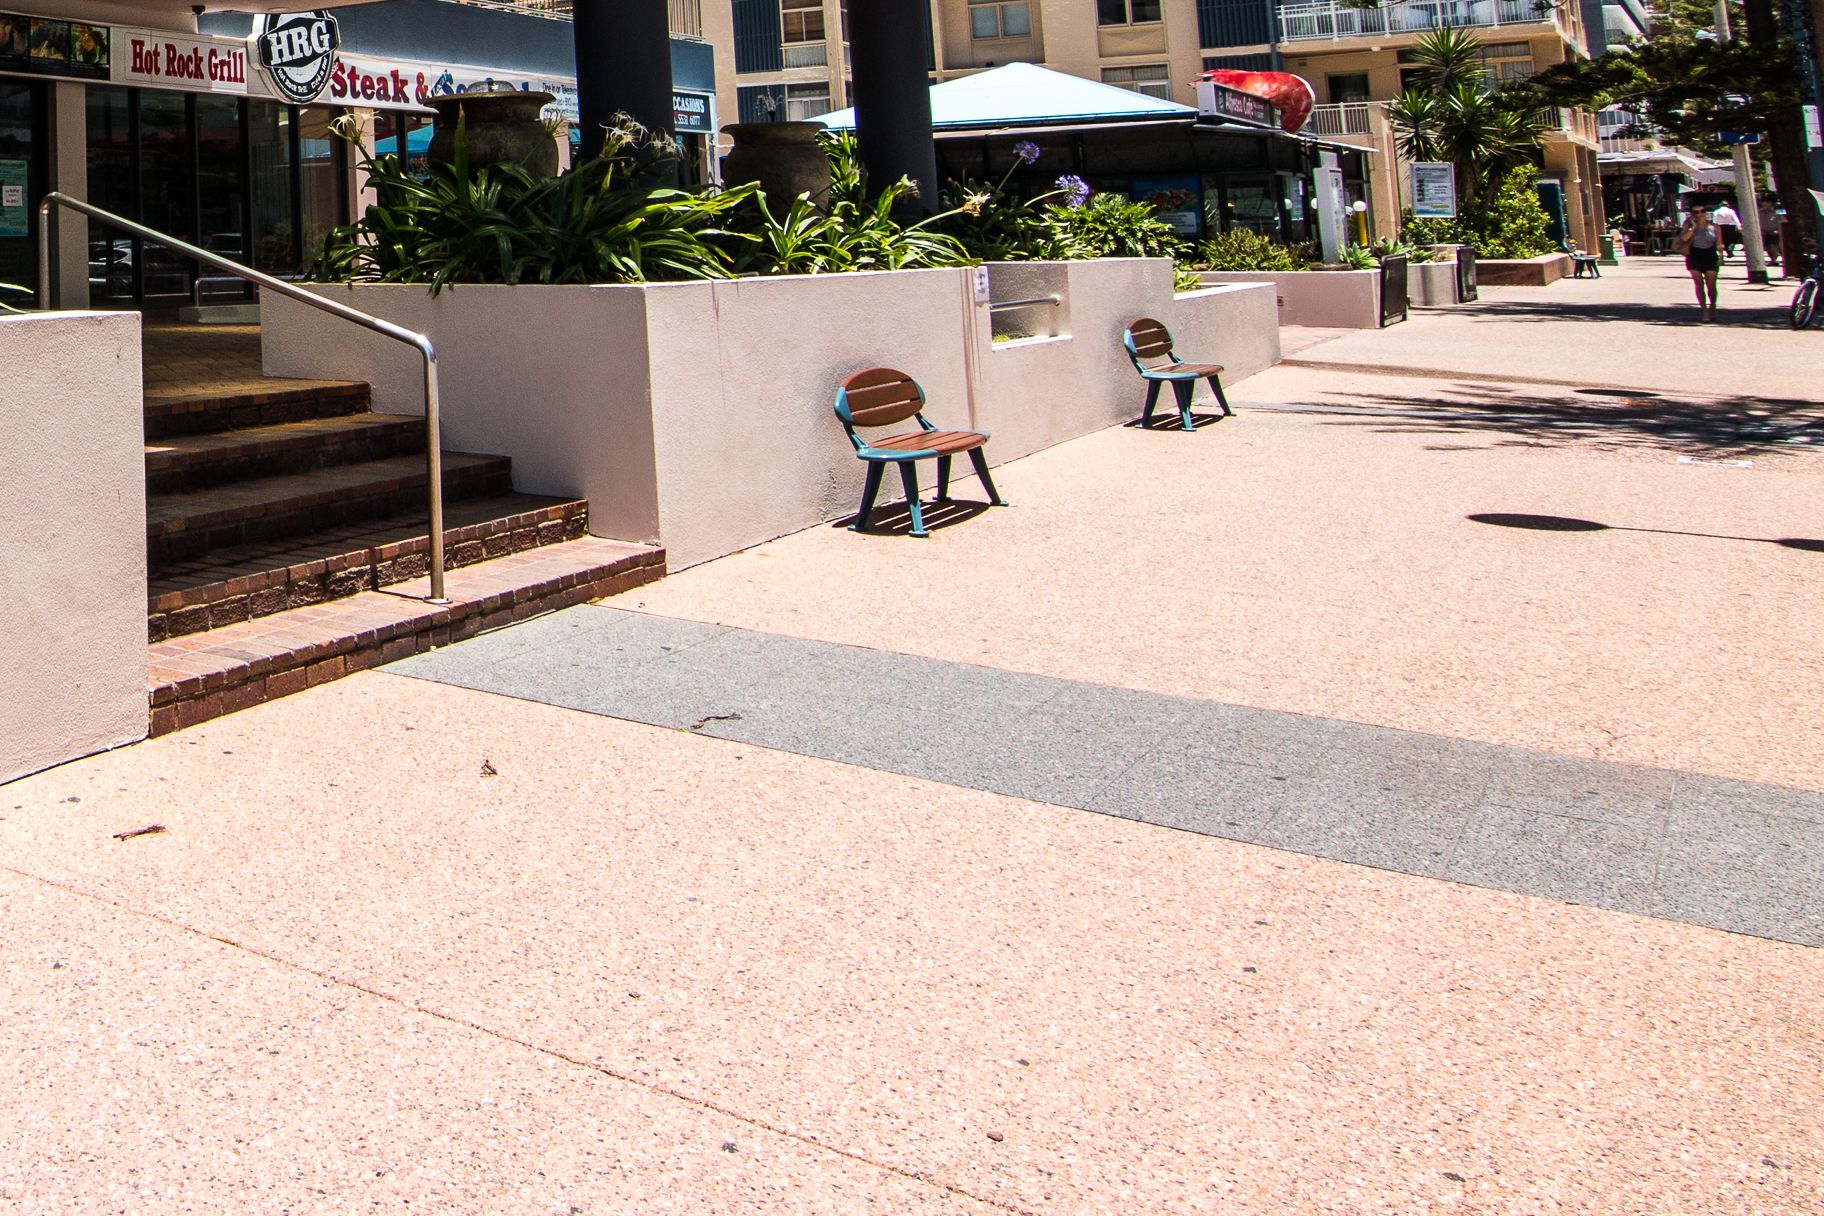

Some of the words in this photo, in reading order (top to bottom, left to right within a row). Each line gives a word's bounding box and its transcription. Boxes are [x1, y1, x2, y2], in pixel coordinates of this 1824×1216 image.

[131, 39, 161, 76] Hot
[165, 43, 204, 79] Rock
[208, 48, 245, 83] Grill
[267, 21, 330, 66] HRG
[330, 57, 410, 104] Steak
[415, 72, 430, 104] &
